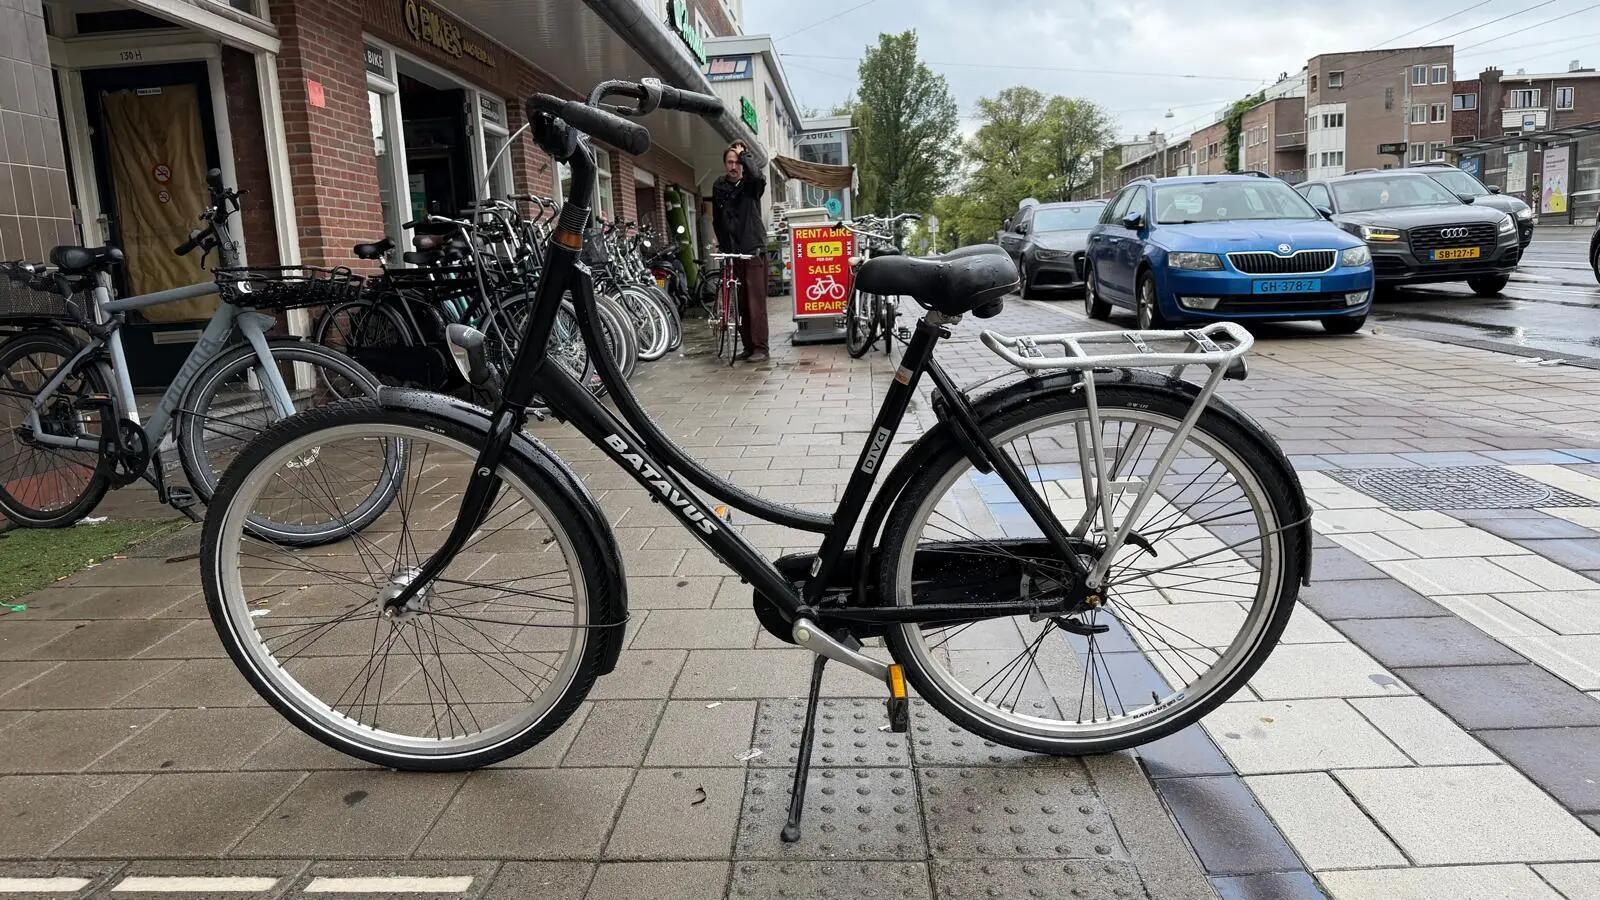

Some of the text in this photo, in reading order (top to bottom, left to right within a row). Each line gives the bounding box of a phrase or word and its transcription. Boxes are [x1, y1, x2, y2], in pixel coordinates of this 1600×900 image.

[367, 50, 384, 69] BIKE
[796, 229, 822, 239] RENT
[829, 228, 853, 238] BIKE
[1439, 249, 1475, 259] SB-127-F
[808, 264, 842, 275] SALES
[1260, 280, 1314, 292] GH-378-Z
[804, 301, 848, 311] REPAIRS
[603, 433, 718, 535] BATAVUS
